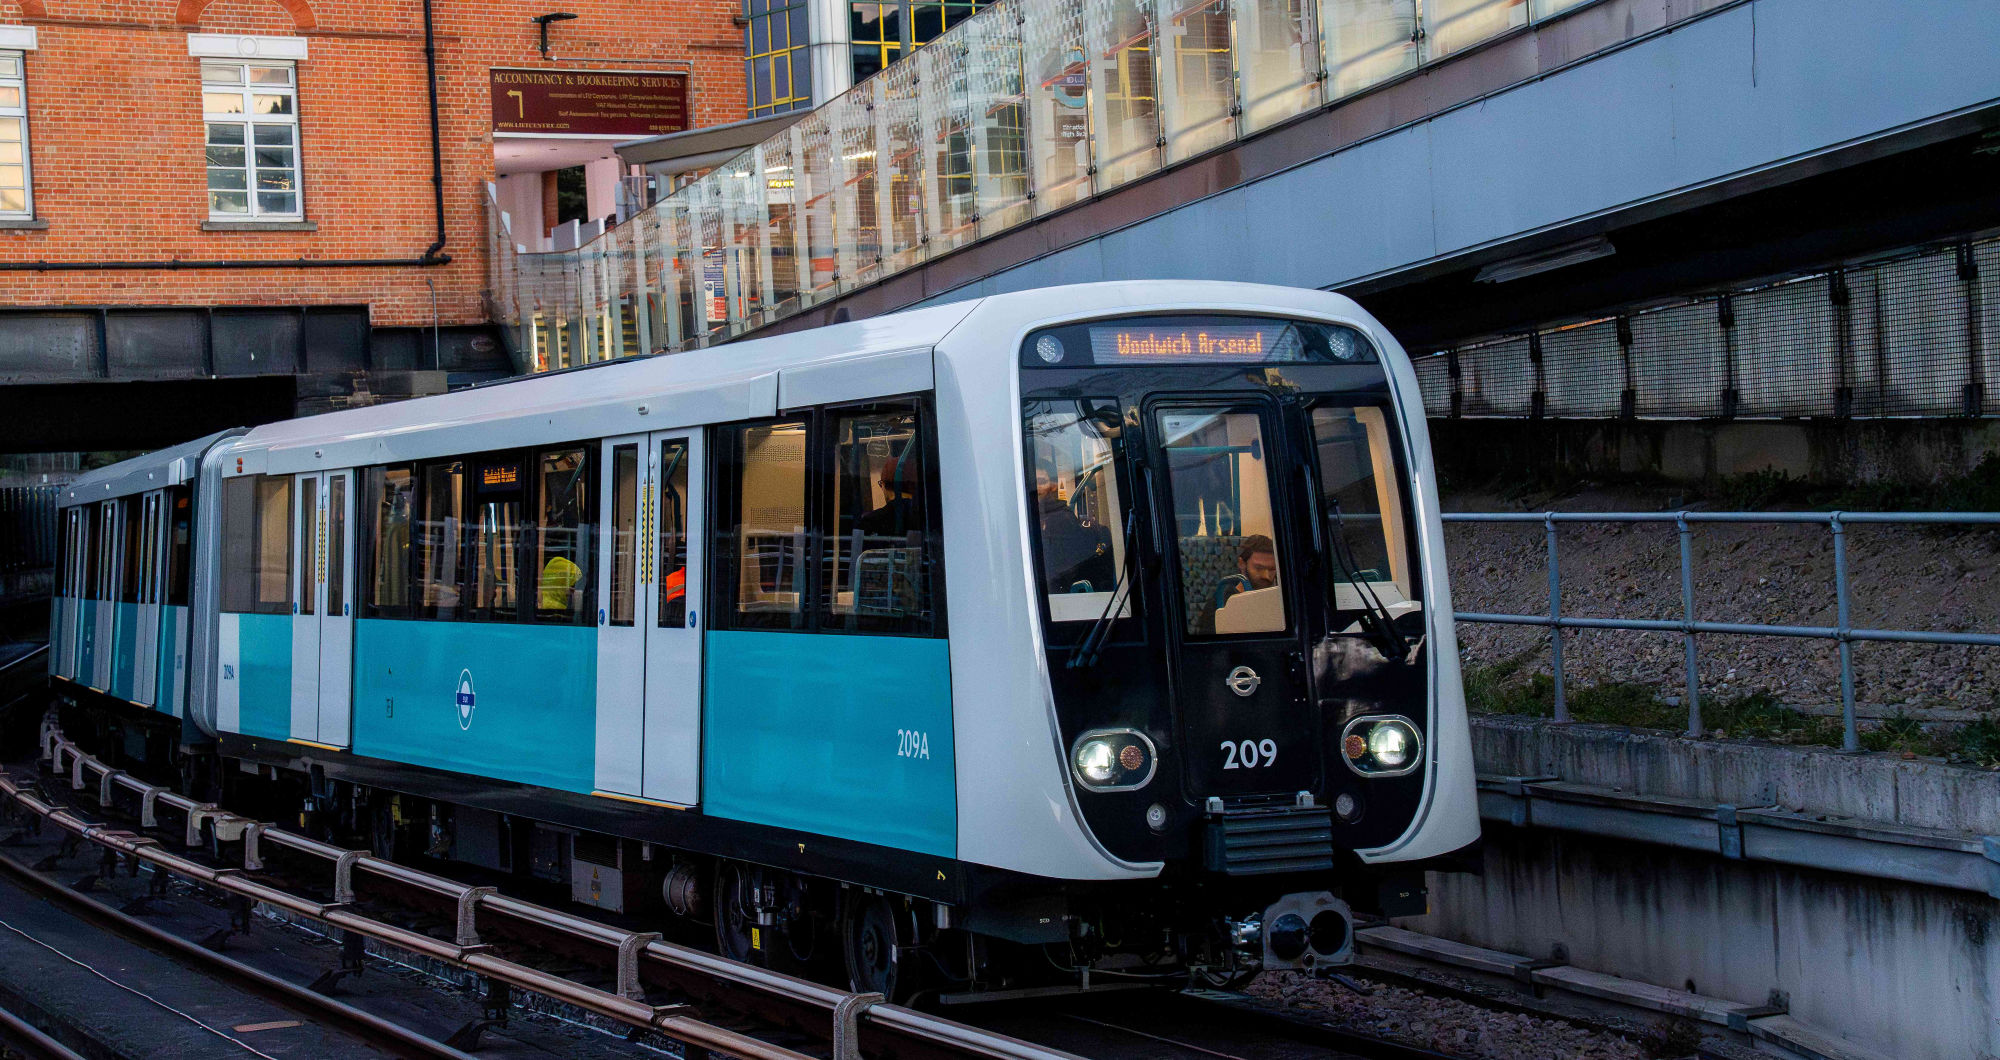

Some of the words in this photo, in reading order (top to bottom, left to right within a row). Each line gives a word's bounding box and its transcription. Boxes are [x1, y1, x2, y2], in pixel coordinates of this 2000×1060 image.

[494, 73, 564, 85] ACCOUNTANCY
[565, 77, 574, 85] &
[577, 75, 639, 87] BOOKKEEPING
[641, 77, 681, 88] SERVICES
[1117, 332, 1192, 355] Woolwich
[1197, 332, 1263, 354] Arsenal
[897, 728, 930, 760] 209A
[1220, 738, 1278, 770] 209
